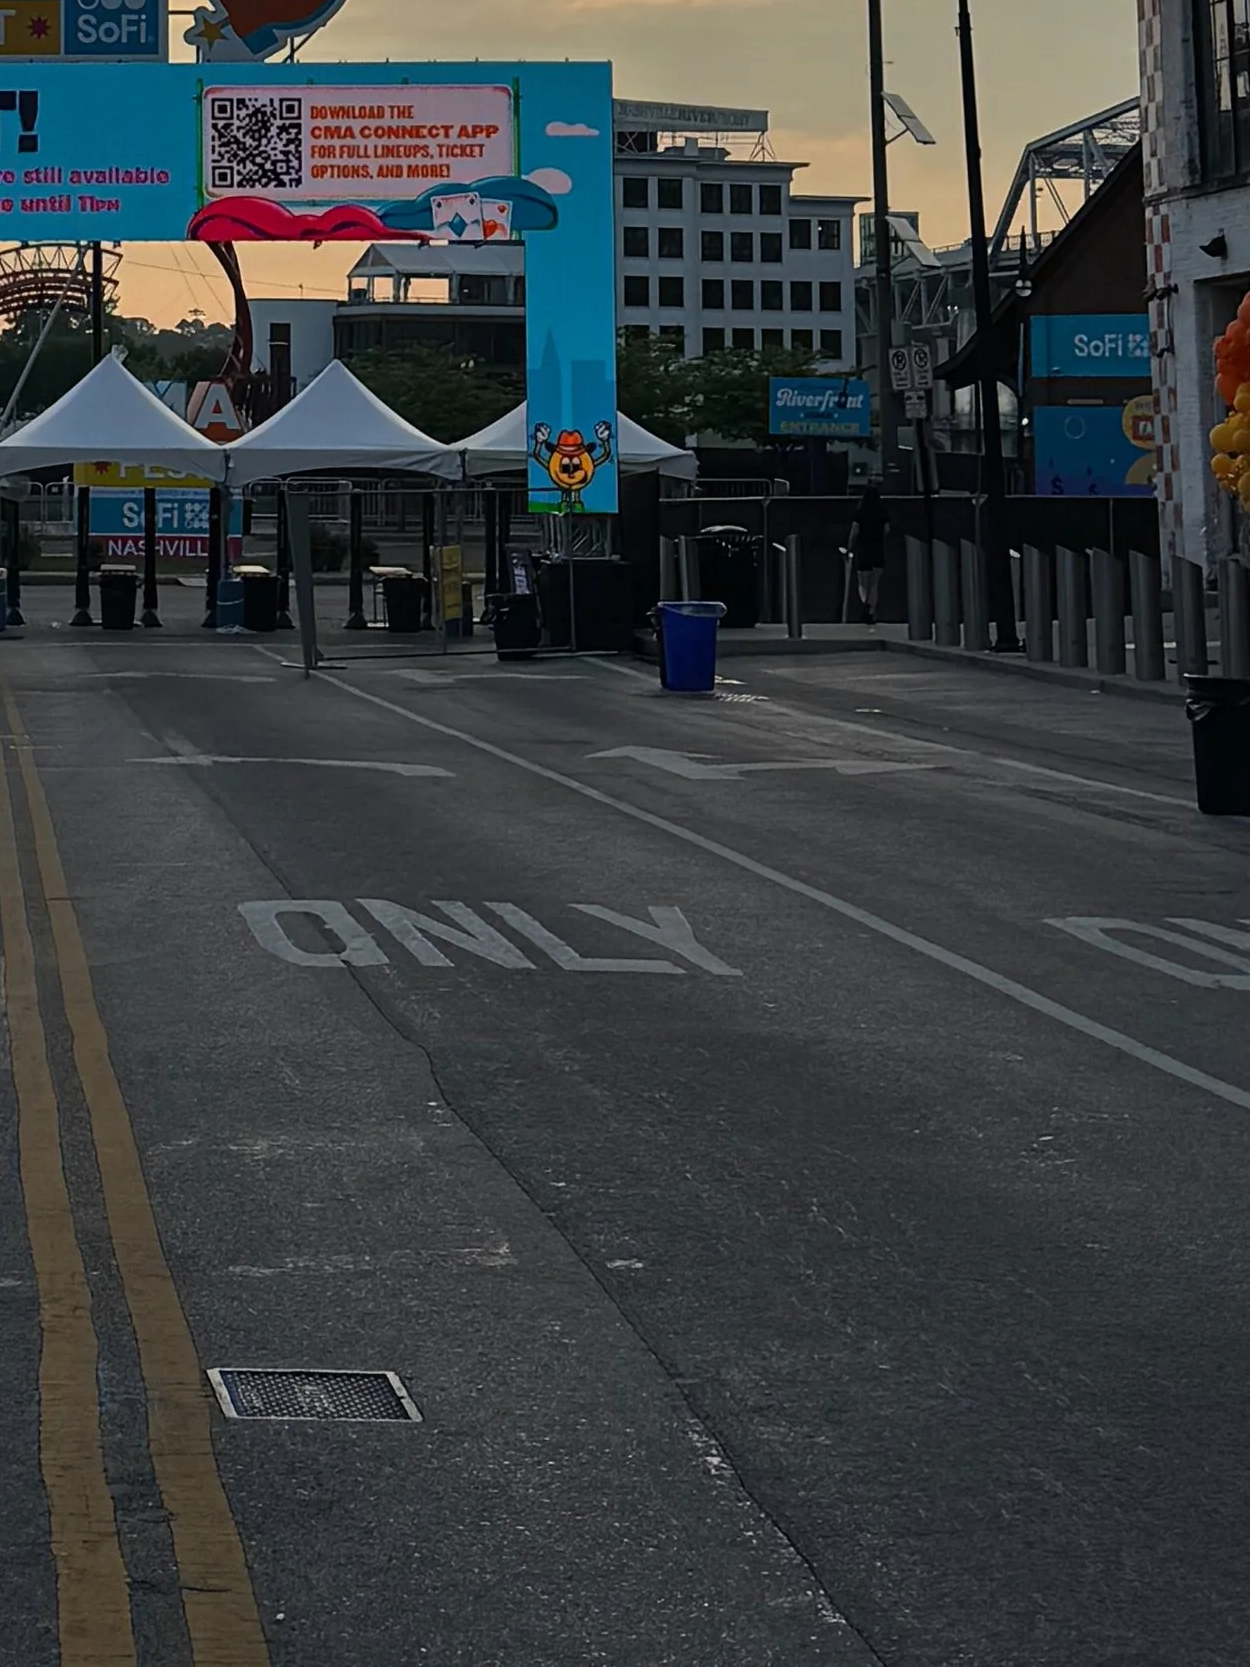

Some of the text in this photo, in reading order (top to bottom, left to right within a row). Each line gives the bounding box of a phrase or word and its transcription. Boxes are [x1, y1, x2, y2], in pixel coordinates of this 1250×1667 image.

[77, 15, 147, 45] SoFi
[310, 105, 415, 120] DOWNLOAD THE
[310, 125, 500, 140] CMA CONNECT APP
[310, 144, 485, 160] FOR FULL LINEUPS, TICKET
[23, 166, 63, 184] still
[69, 166, 170, 184] available
[310, 164, 451, 180] OPTIONS, AND MORE!
[21, 194, 72, 212] until
[1074, 334, 1122, 357] SoFi
[776, 387, 864, 411] Riverfrnt
[108, 538, 209, 557] NASHVILL
[237, 898, 744, 976] ONLY
